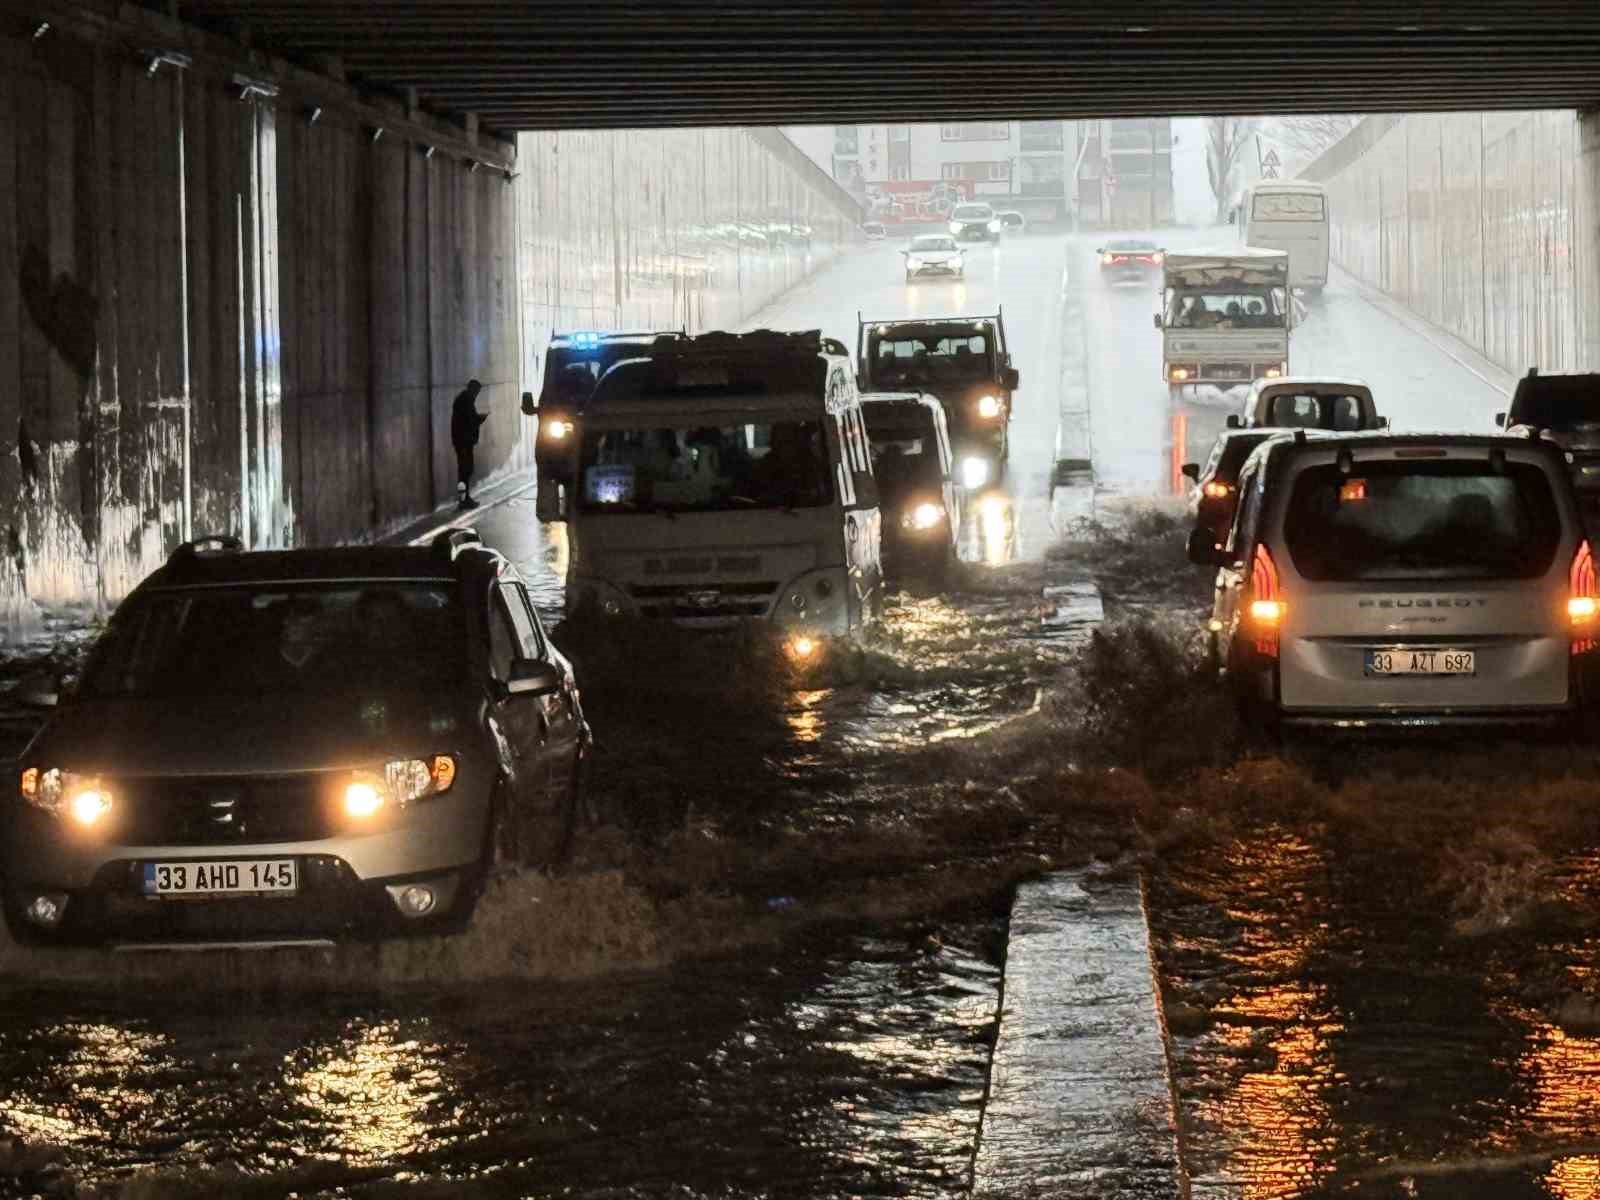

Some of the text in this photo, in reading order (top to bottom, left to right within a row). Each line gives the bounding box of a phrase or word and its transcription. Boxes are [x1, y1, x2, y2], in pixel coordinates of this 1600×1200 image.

[1358, 598, 1486, 609] PEUGEOT
[1374, 652, 1472, 673] 33 AZT 692
[157, 862, 293, 890] 33 AHD 145
